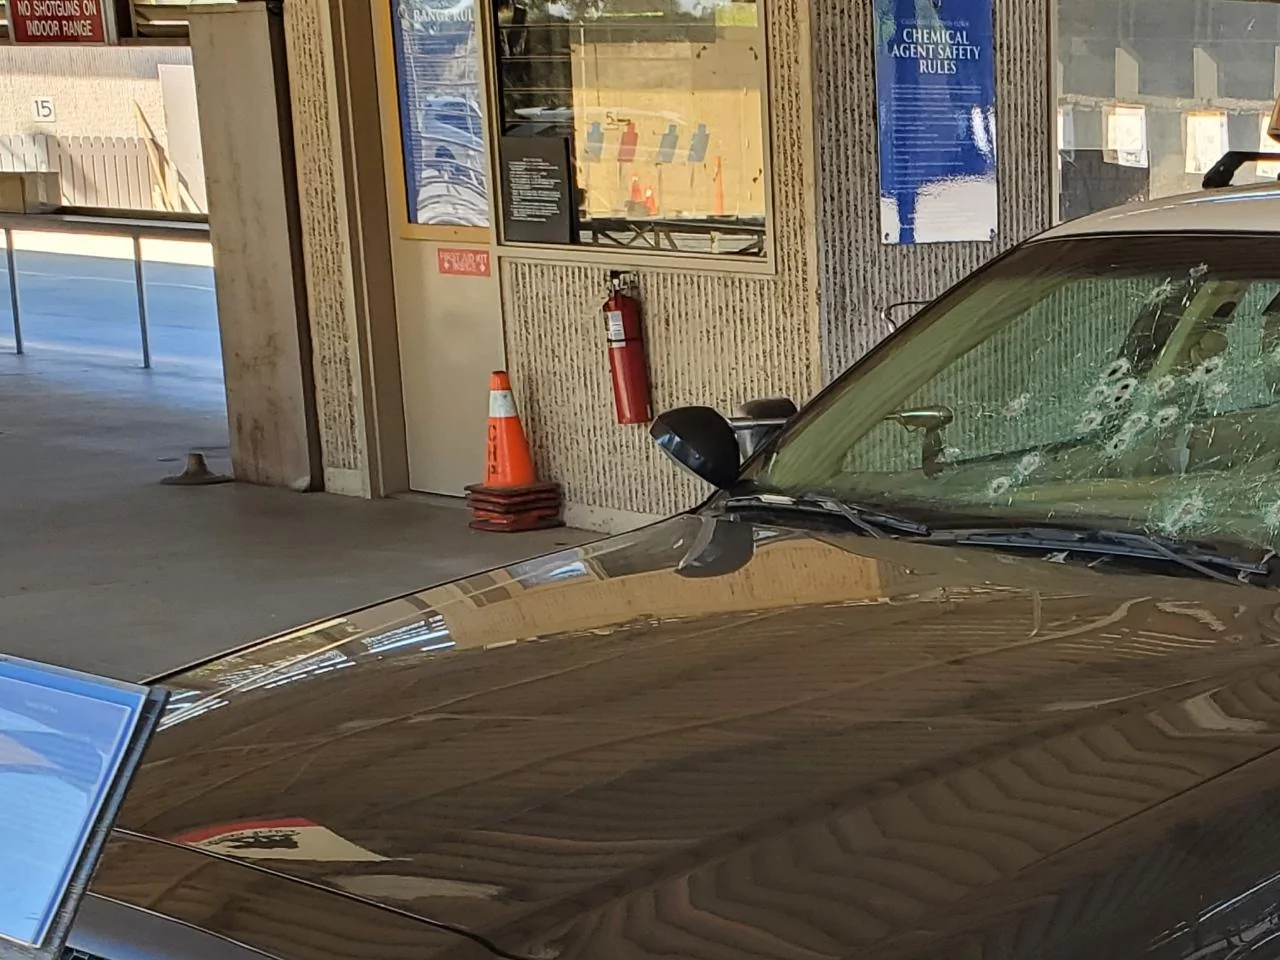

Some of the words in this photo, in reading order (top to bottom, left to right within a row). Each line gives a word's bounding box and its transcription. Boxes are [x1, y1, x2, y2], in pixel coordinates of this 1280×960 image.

[17, 0, 31, 16] NO
[33, 0, 80, 17] SHOTGUNS
[82, 0, 97, 16] ON
[26, 20, 60, 36] INDOOR
[62, 20, 93, 36] RANGE
[902, 28, 970, 44] CHEMICAL
[891, 44, 935, 58] AGENT
[937, 45, 981, 60] SAFETY
[919, 59, 957, 74] RULES
[34, 99, 52, 118] 15
